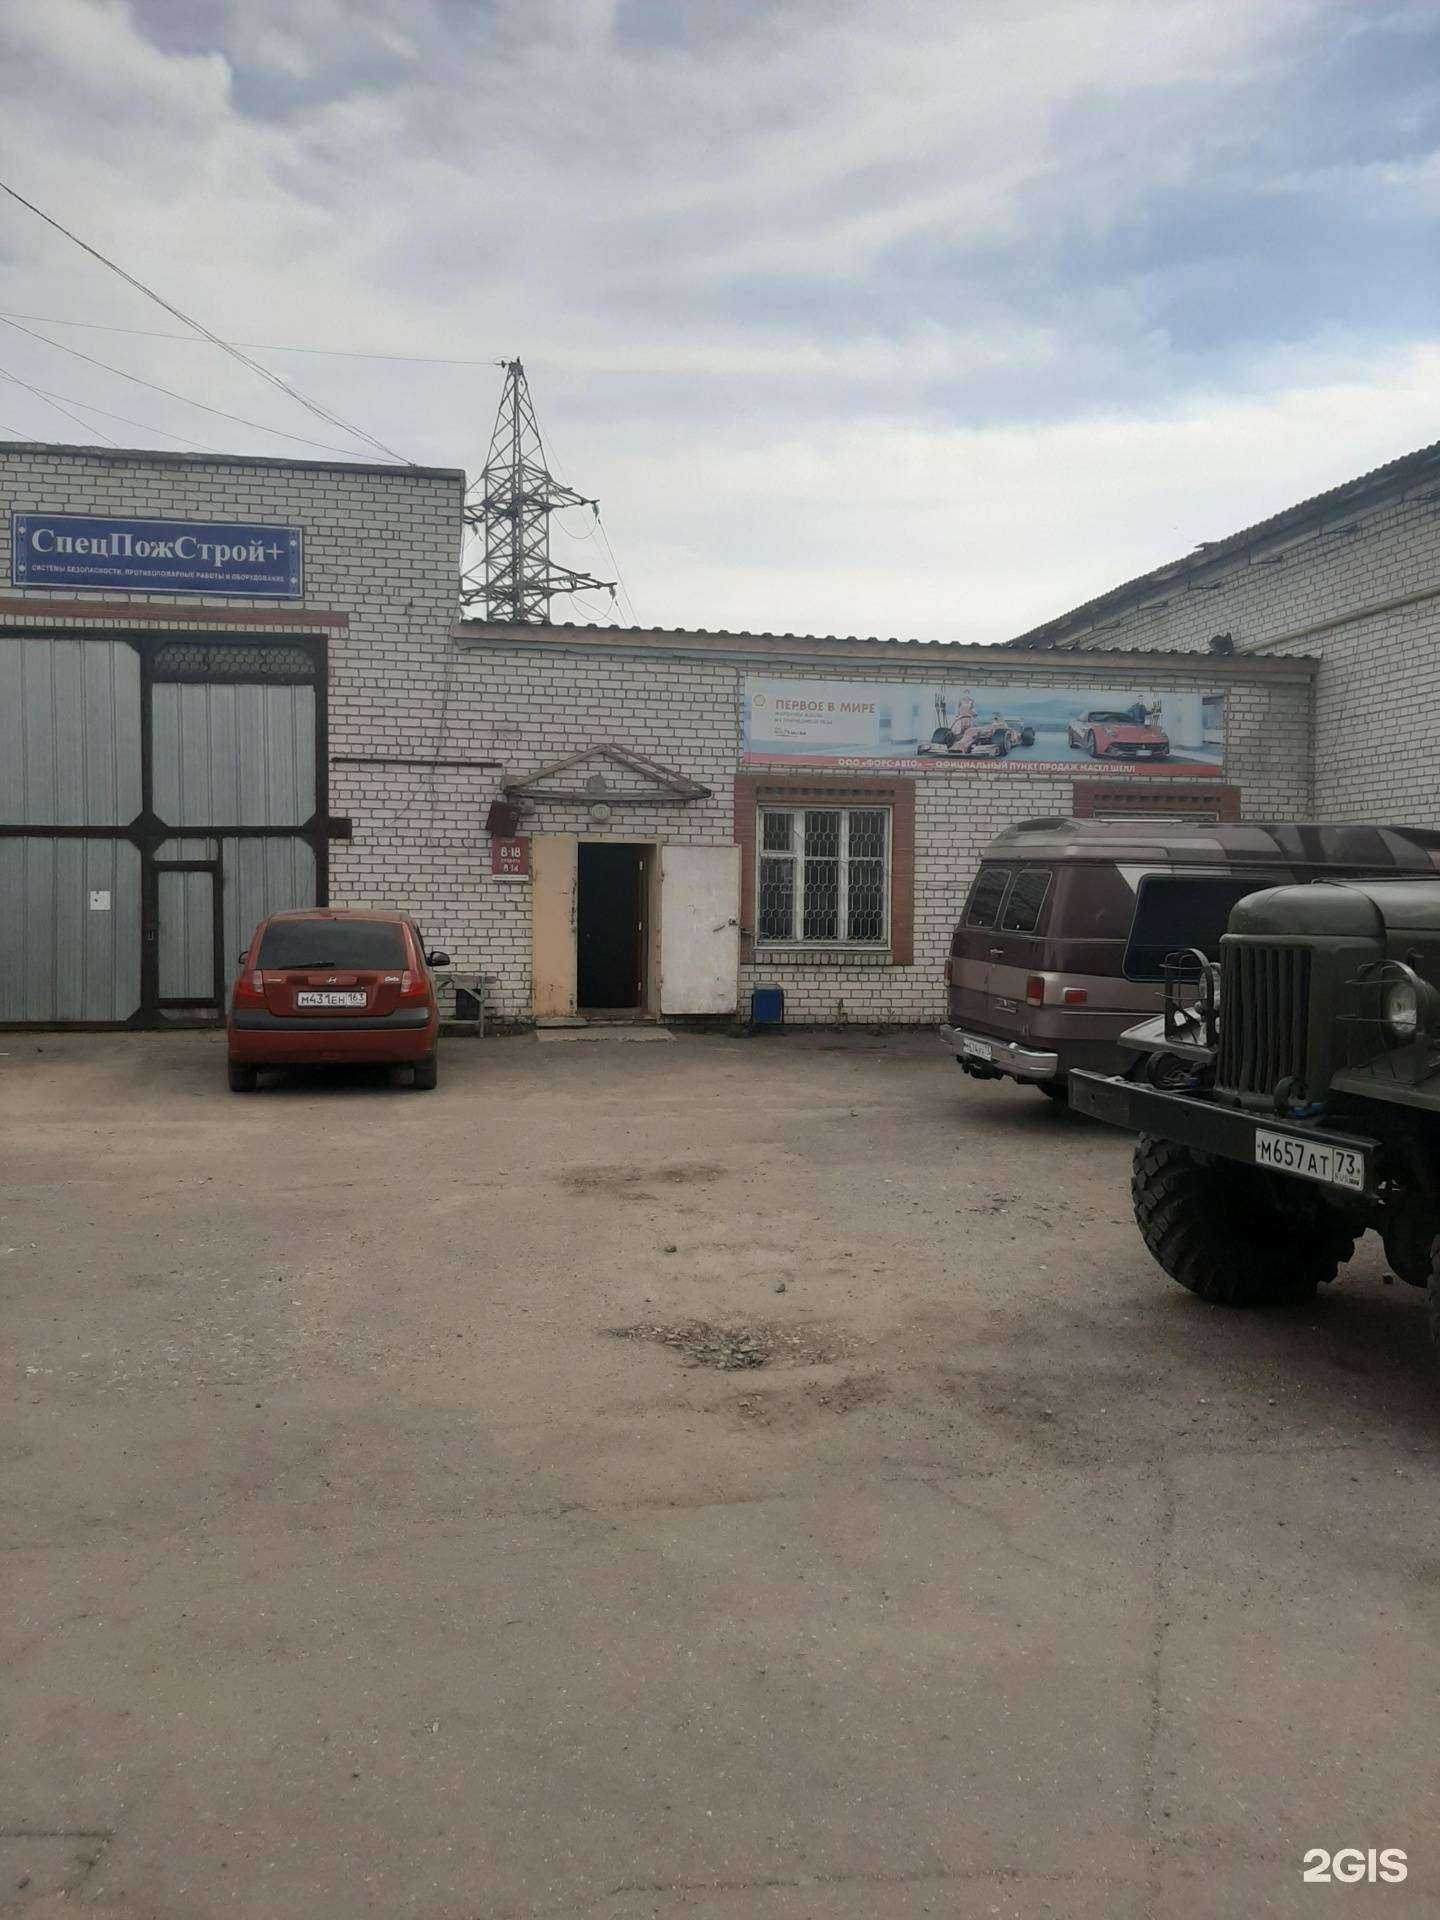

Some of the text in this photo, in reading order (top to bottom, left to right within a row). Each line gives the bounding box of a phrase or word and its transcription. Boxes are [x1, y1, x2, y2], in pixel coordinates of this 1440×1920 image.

[31, 528, 284, 567] СпецПожСтрой+
[775, 699, 876, 714] ПЕРВОЕ В МИРЕ
[838, 758, 860, 767] ООО
[935, 760, 1008, 769] ОФИЦИАЛЬНЫЙ
[1009, 762, 1038, 771] ПУНКТ
[1040, 762, 1079, 772] ПРОДАЖ
[1261, 1139, 1355, 1175] М657АТ 73
